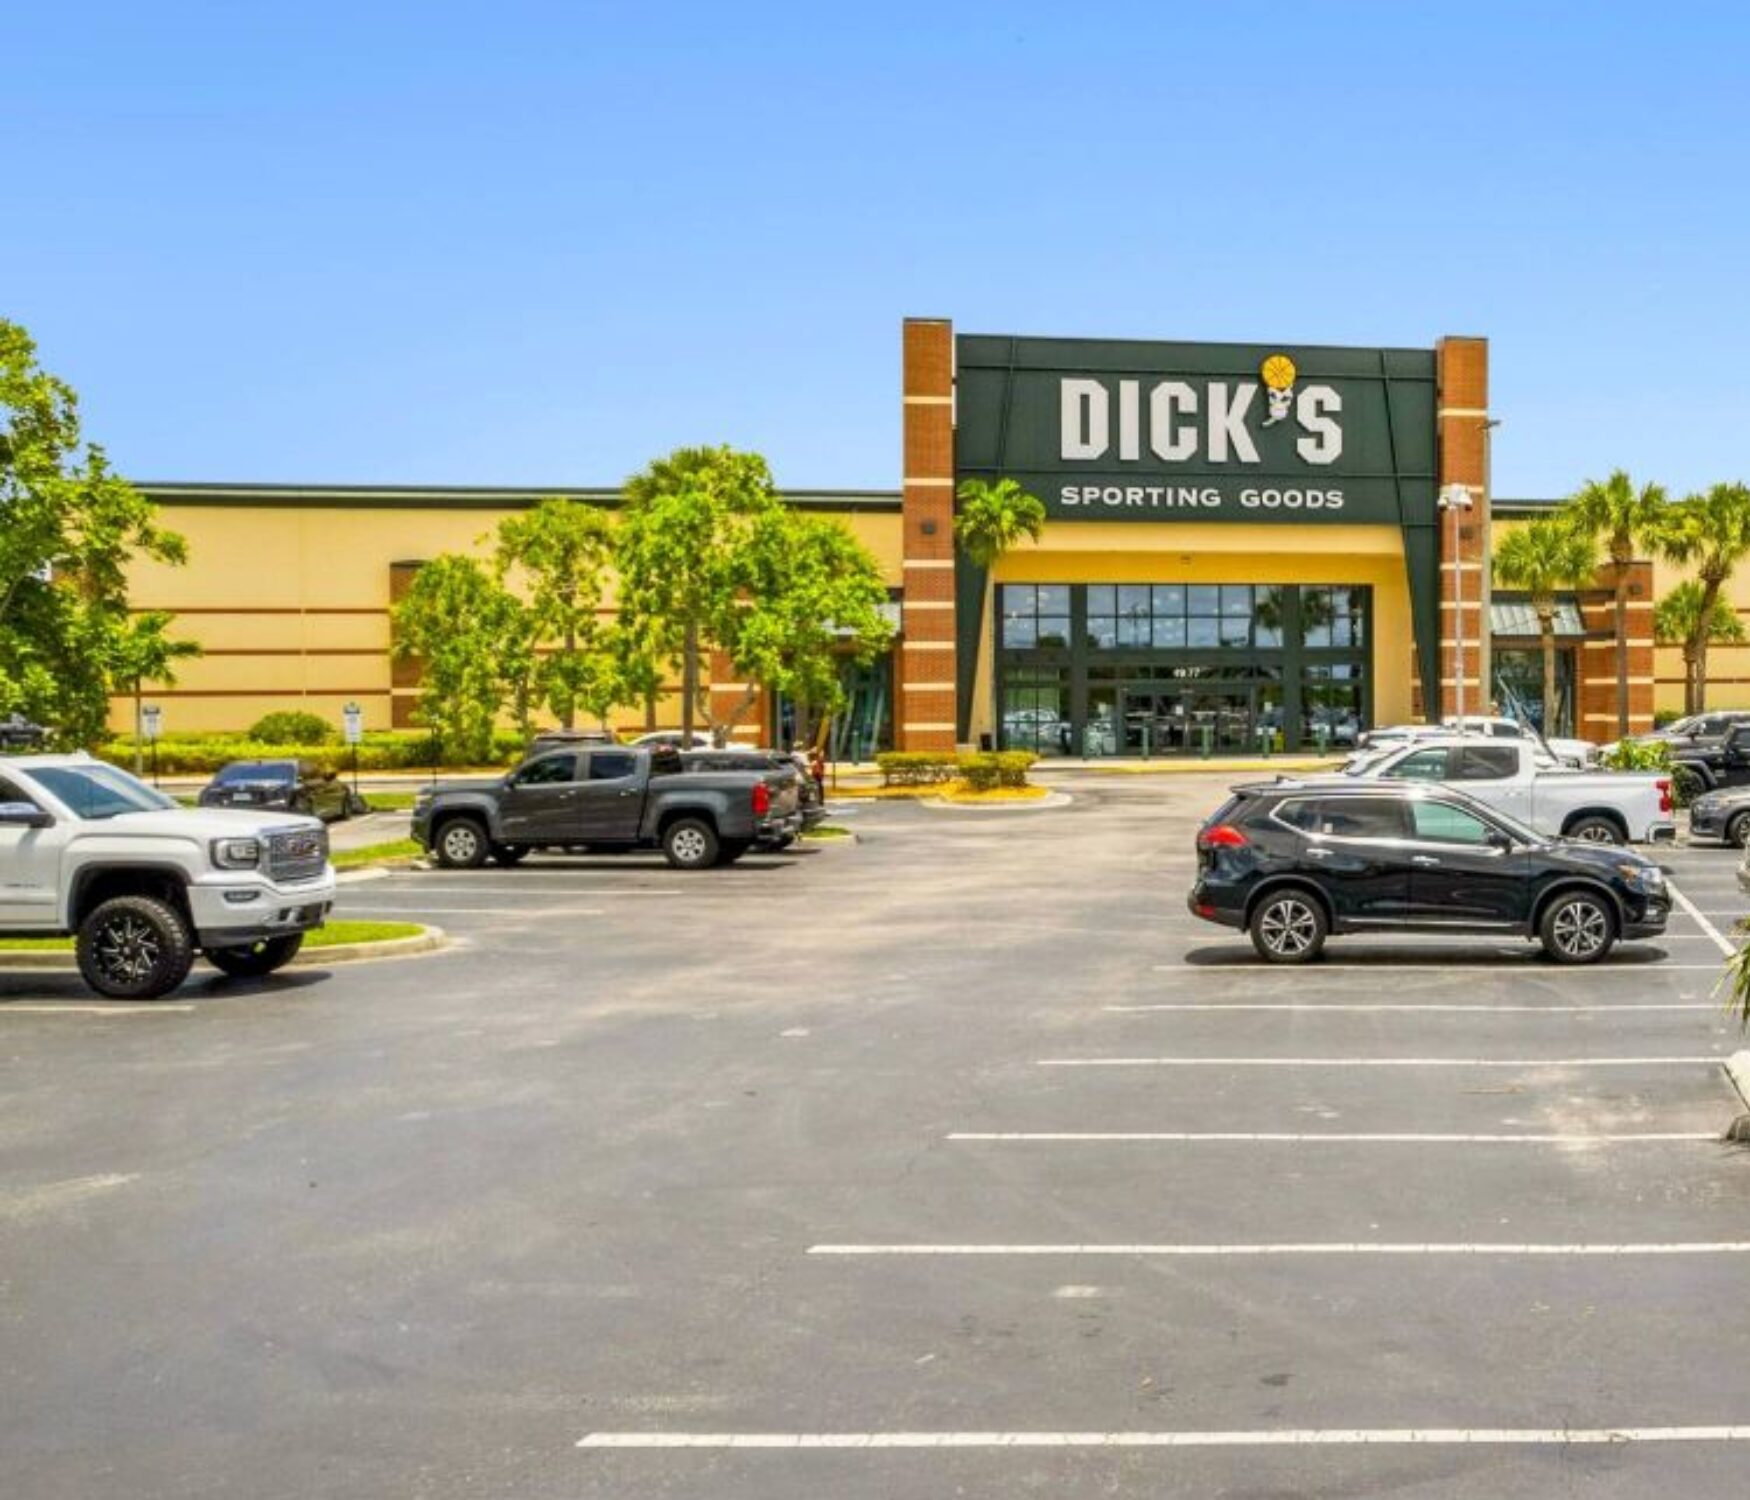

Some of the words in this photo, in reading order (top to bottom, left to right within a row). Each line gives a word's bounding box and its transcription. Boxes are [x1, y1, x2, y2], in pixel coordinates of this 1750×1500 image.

[1060, 355, 1343, 465] DICK'S
[1060, 486, 1222, 507] SPORTING
[1240, 488, 1345, 508] GOODS
